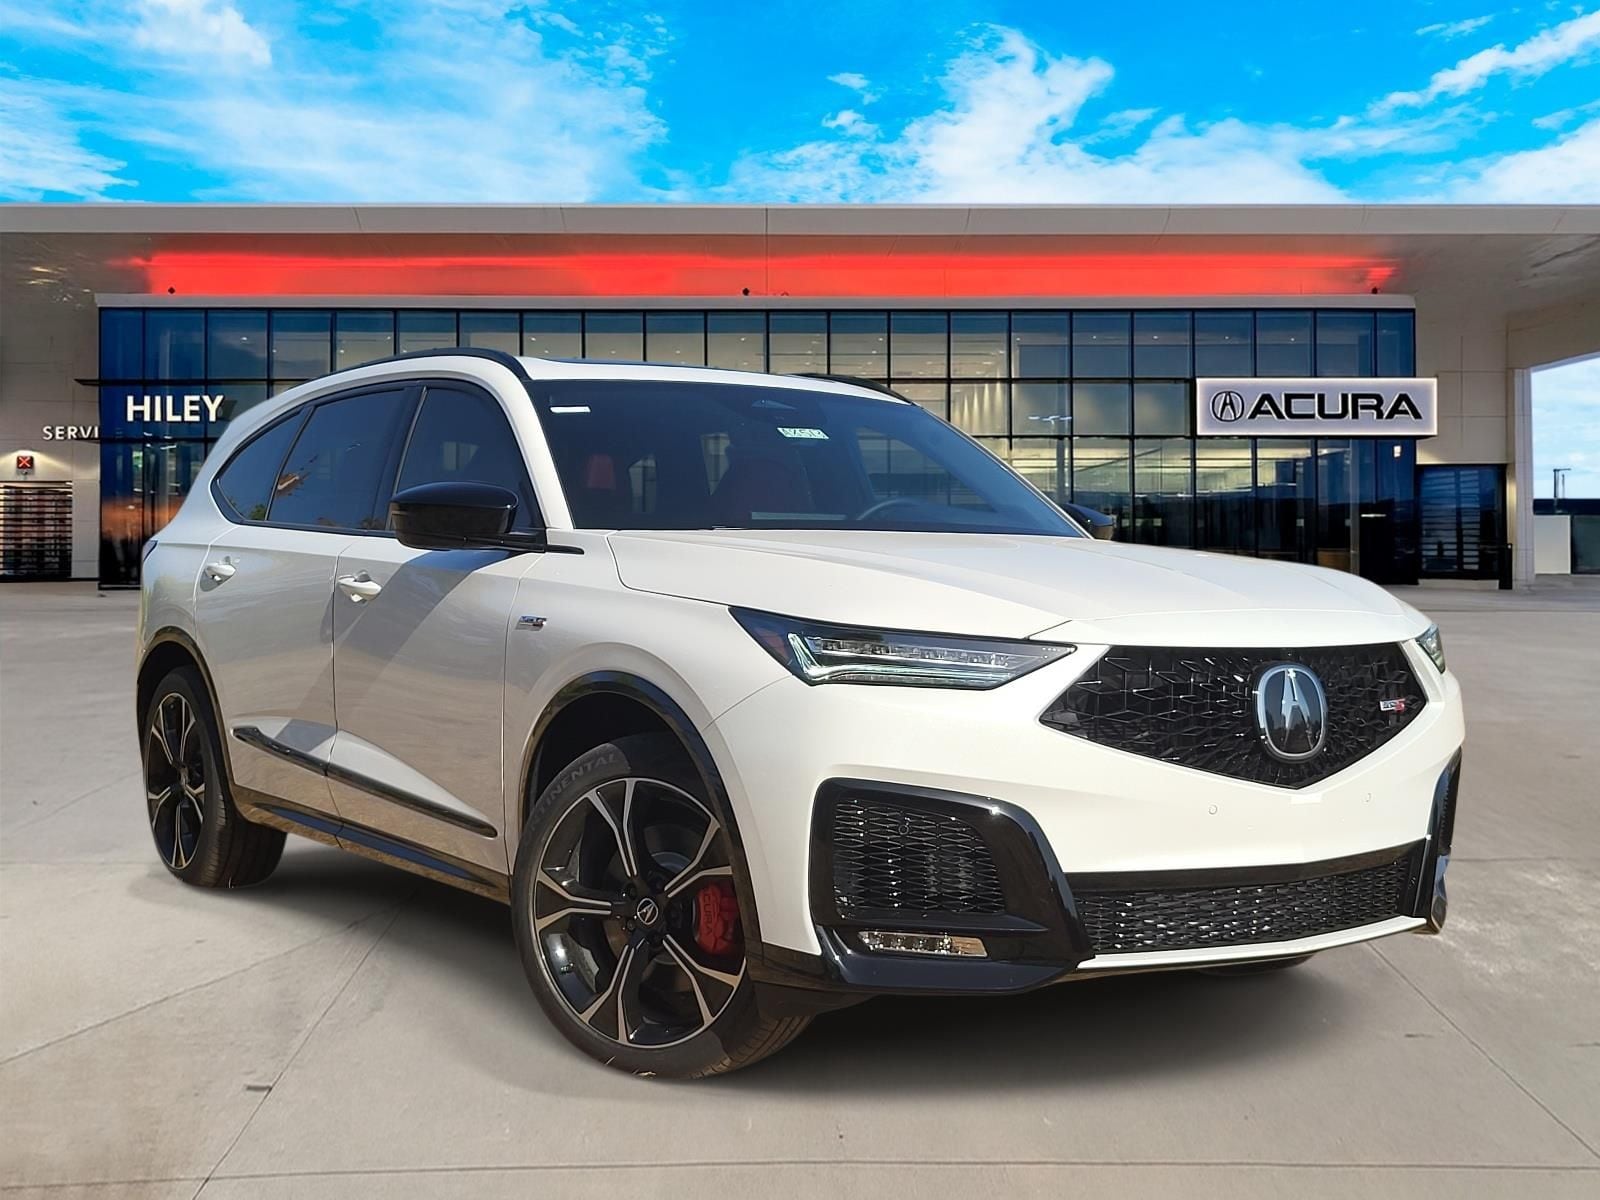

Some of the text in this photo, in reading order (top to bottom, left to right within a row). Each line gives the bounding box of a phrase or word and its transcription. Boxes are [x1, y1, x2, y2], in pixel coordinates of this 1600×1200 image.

[126, 395, 224, 422] HILEY
[1247, 392, 1422, 420] ACURA
[42, 425, 99, 440] SERVI
